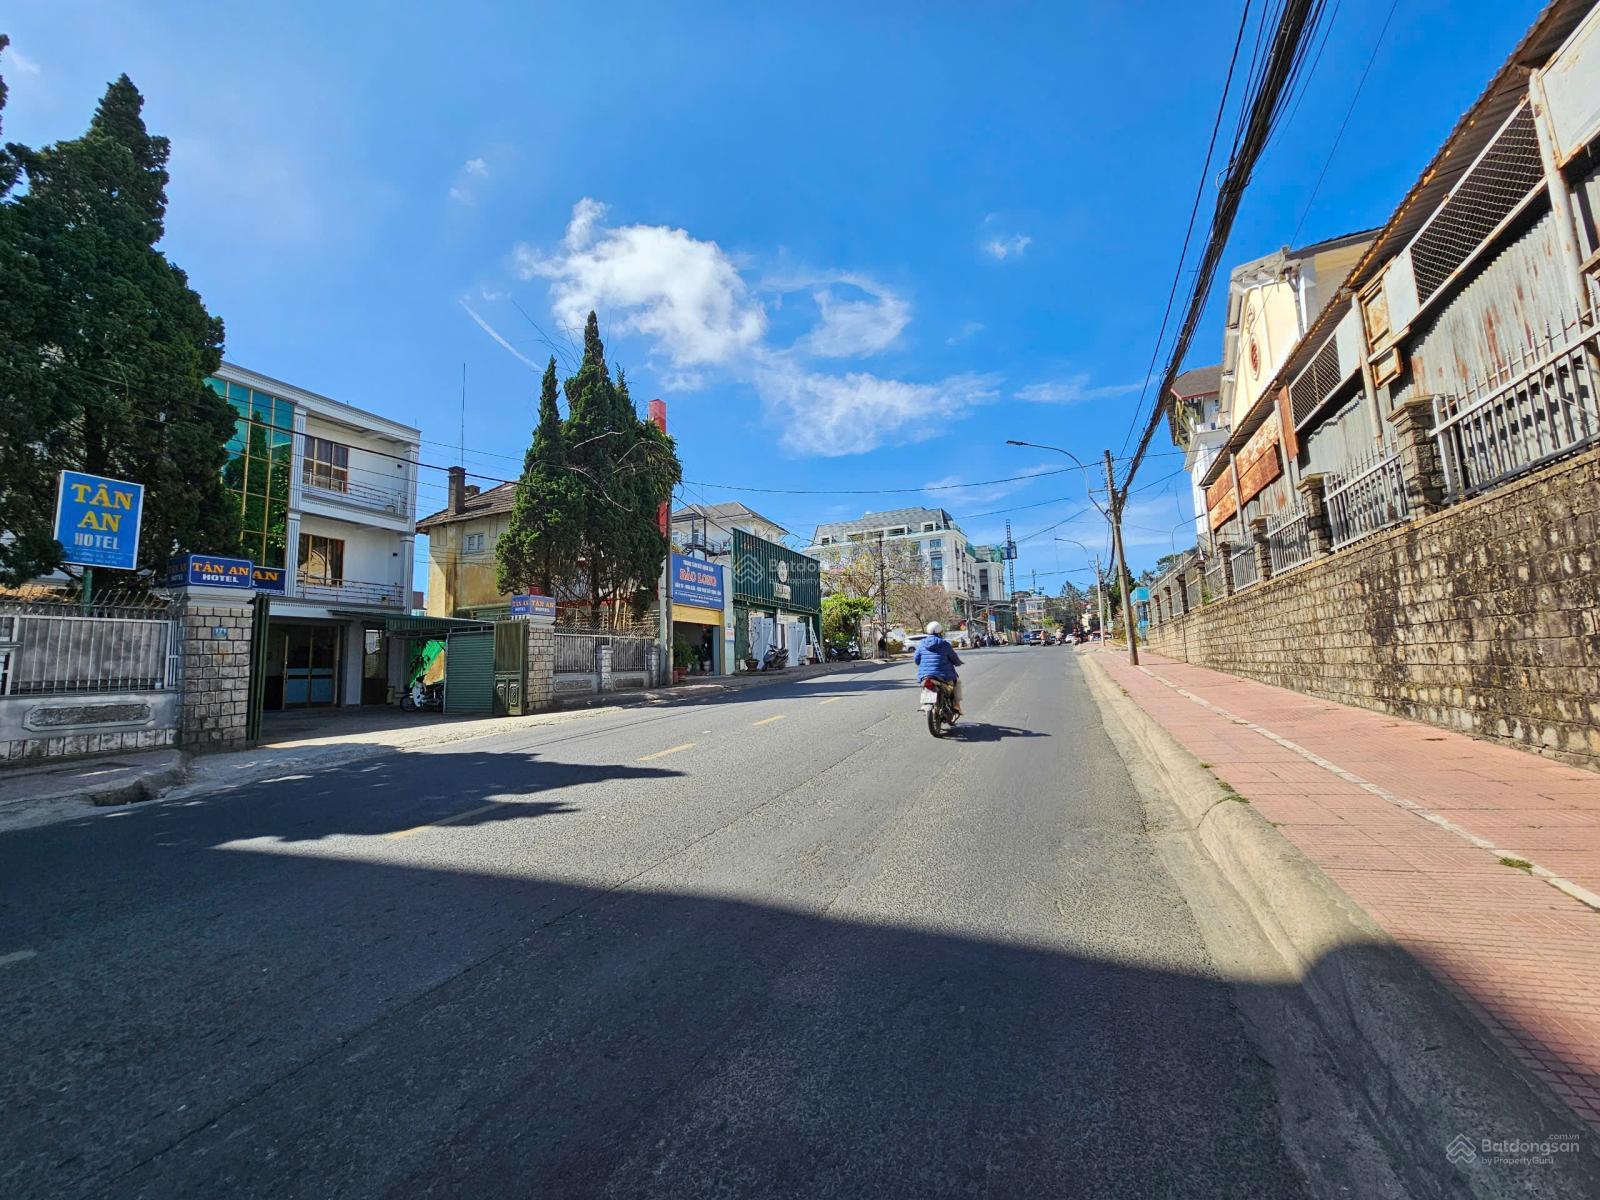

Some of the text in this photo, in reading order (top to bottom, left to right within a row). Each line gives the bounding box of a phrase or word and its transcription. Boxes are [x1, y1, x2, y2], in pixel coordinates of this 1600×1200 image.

[71, 482, 133, 510] TÂN
[77, 510, 122, 532] AN
[74, 532, 120, 549] HOTEL
[192, 562, 224, 573] TÂN
[229, 566, 249, 576] AN
[252, 570, 280, 580] AN
[202, 574, 240, 583] HOTEL
